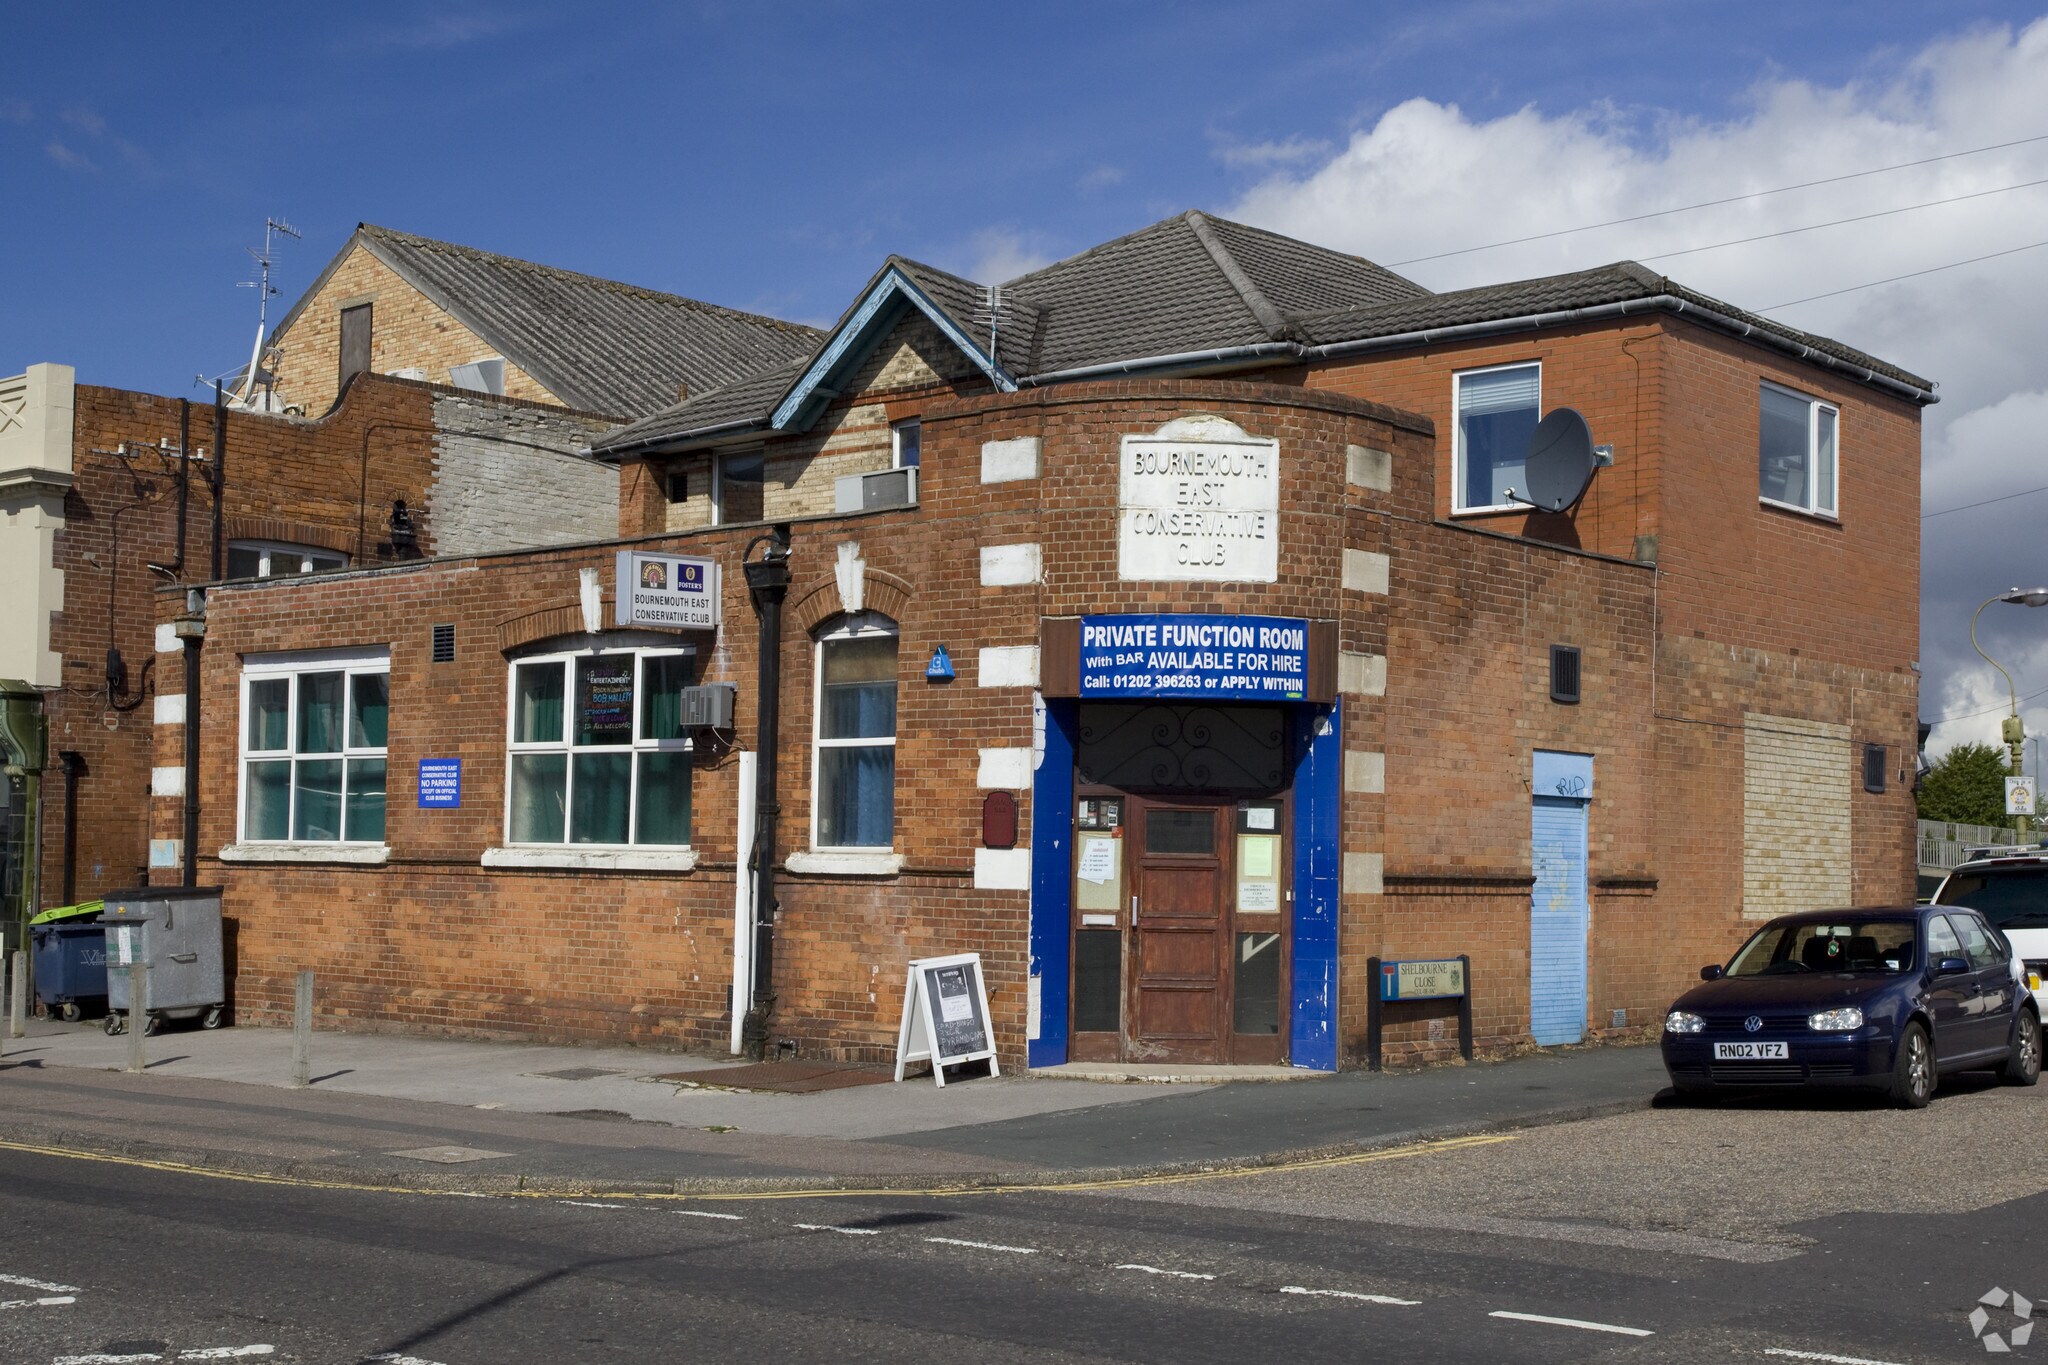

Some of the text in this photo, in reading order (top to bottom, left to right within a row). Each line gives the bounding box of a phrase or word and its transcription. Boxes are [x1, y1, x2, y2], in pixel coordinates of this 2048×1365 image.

[1134, 453, 1268, 479] BOURNEMOUTH
[1177, 482, 1225, 506] EAST
[1134, 513, 1265, 540] CONSERVATIVE
[1177, 543, 1226, 566] CLUB
[679, 581, 702, 590] FOSTER'S
[635, 594, 710, 609] BOURNEMOUTH EAST
[635, 609, 710, 624] CONSERVATIVE CLUB
[1083, 625, 1303, 651] PRIVATE FUNCTION ROOM
[1086, 652, 1302, 673] With BAR AVAILABLE FOR HIRE
[1084, 675, 1303, 691] Call: 01202 396263 or APPLY WITHIN
[421, 779, 457, 787] NO PARKING
[1400, 963, 1447, 975] SHELBOURNE
[1414, 976, 1435, 988] CLOSE
[1719, 1044, 1783, 1057] RN02 VFZ
